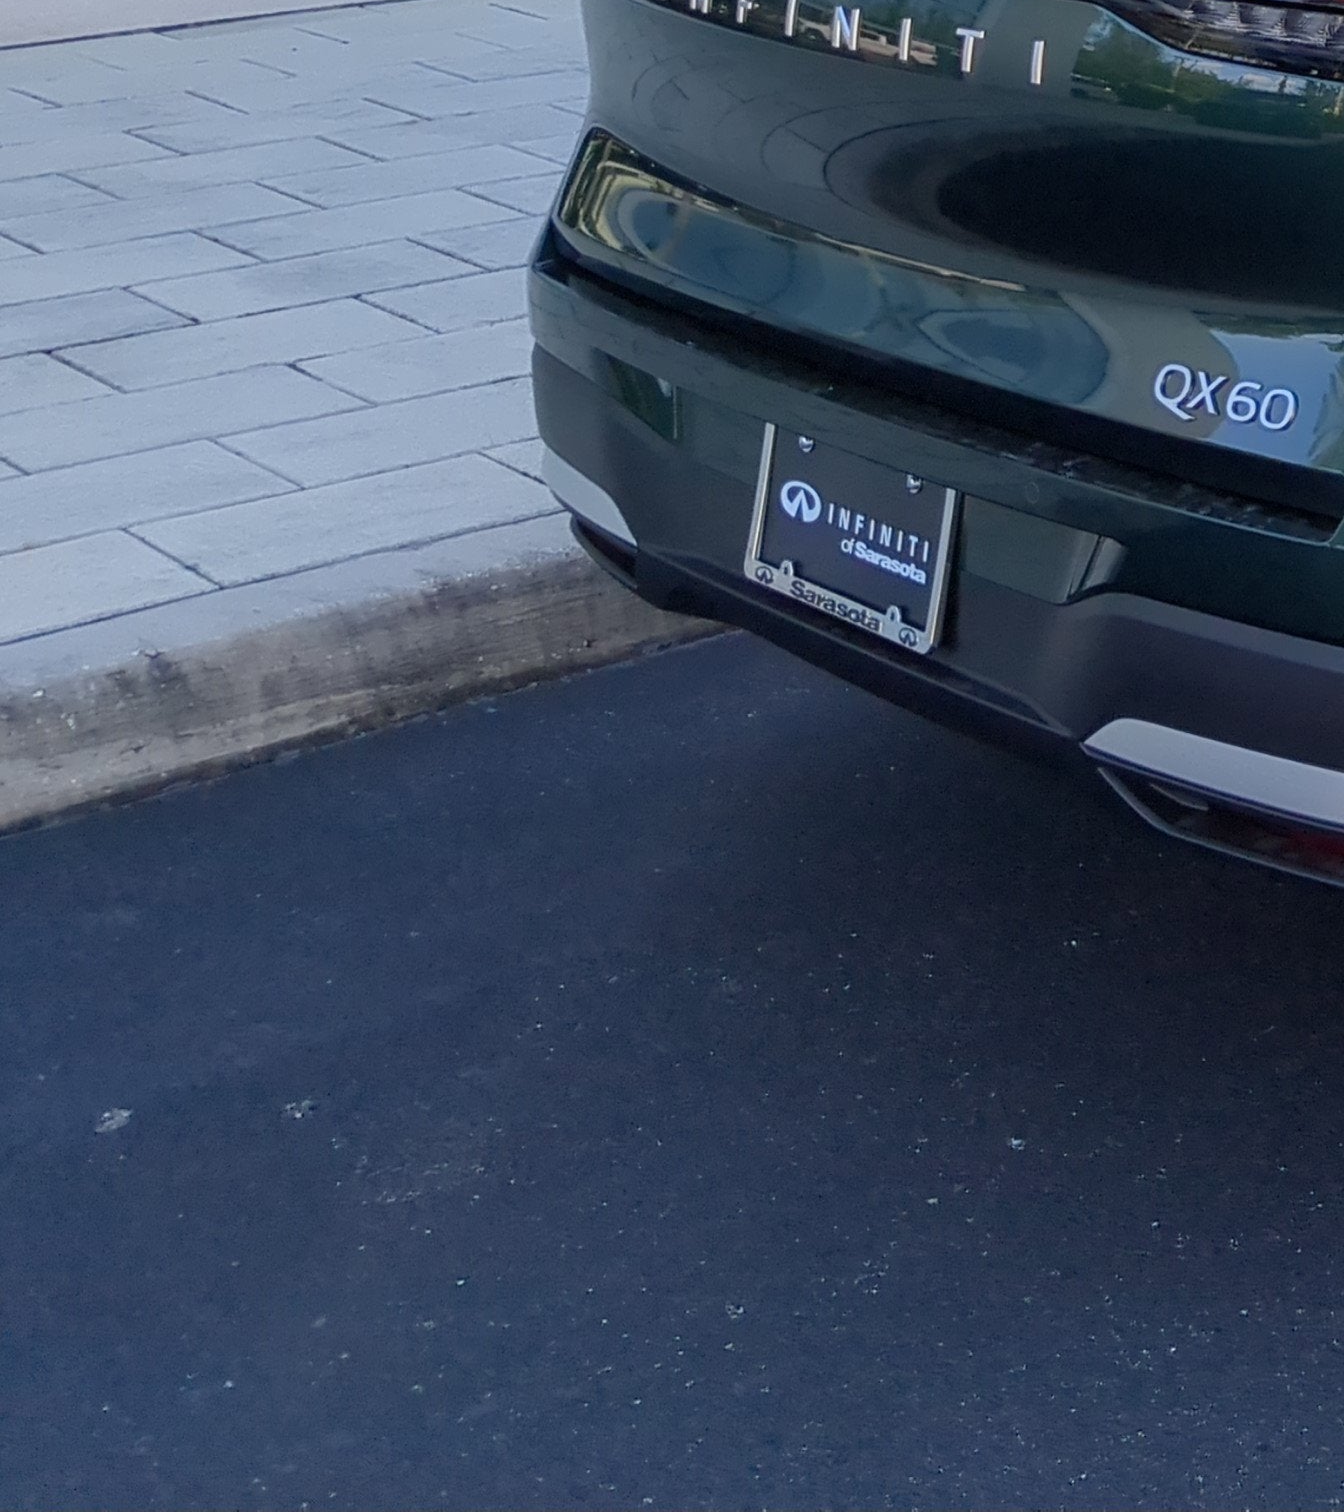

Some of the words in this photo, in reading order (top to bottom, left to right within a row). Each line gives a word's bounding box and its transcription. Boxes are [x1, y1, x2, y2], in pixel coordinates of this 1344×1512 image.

[1153, 363, 1299, 431] QX60
[826, 502, 931, 563] INFINITI
[840, 536, 856, 556] of
[854, 543, 928, 586] Sarasota
[789, 579, 882, 633] Sarasota
